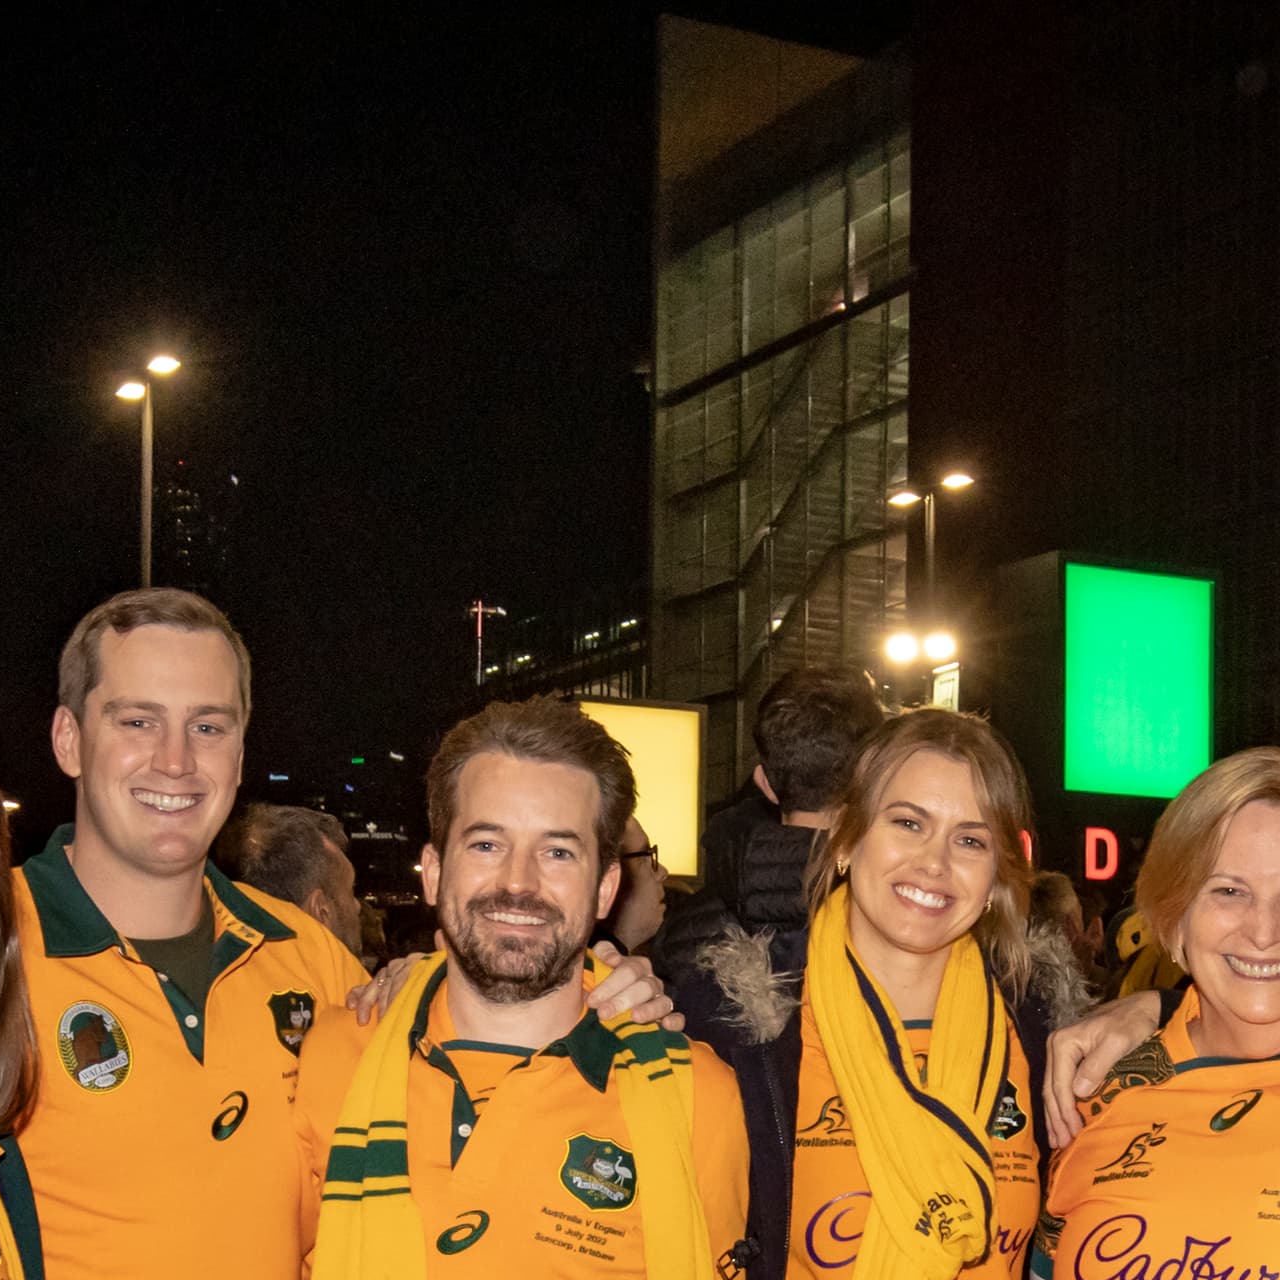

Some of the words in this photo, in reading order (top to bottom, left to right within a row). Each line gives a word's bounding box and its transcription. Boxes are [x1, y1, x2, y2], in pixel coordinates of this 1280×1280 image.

[1085, 826, 1119, 881] D
[541, 1206, 583, 1225] Australia
[564, 1228, 584, 1241] July
[586, 1233, 608, 1246] 2022
[578, 1244, 616, 1261] Brisbane
